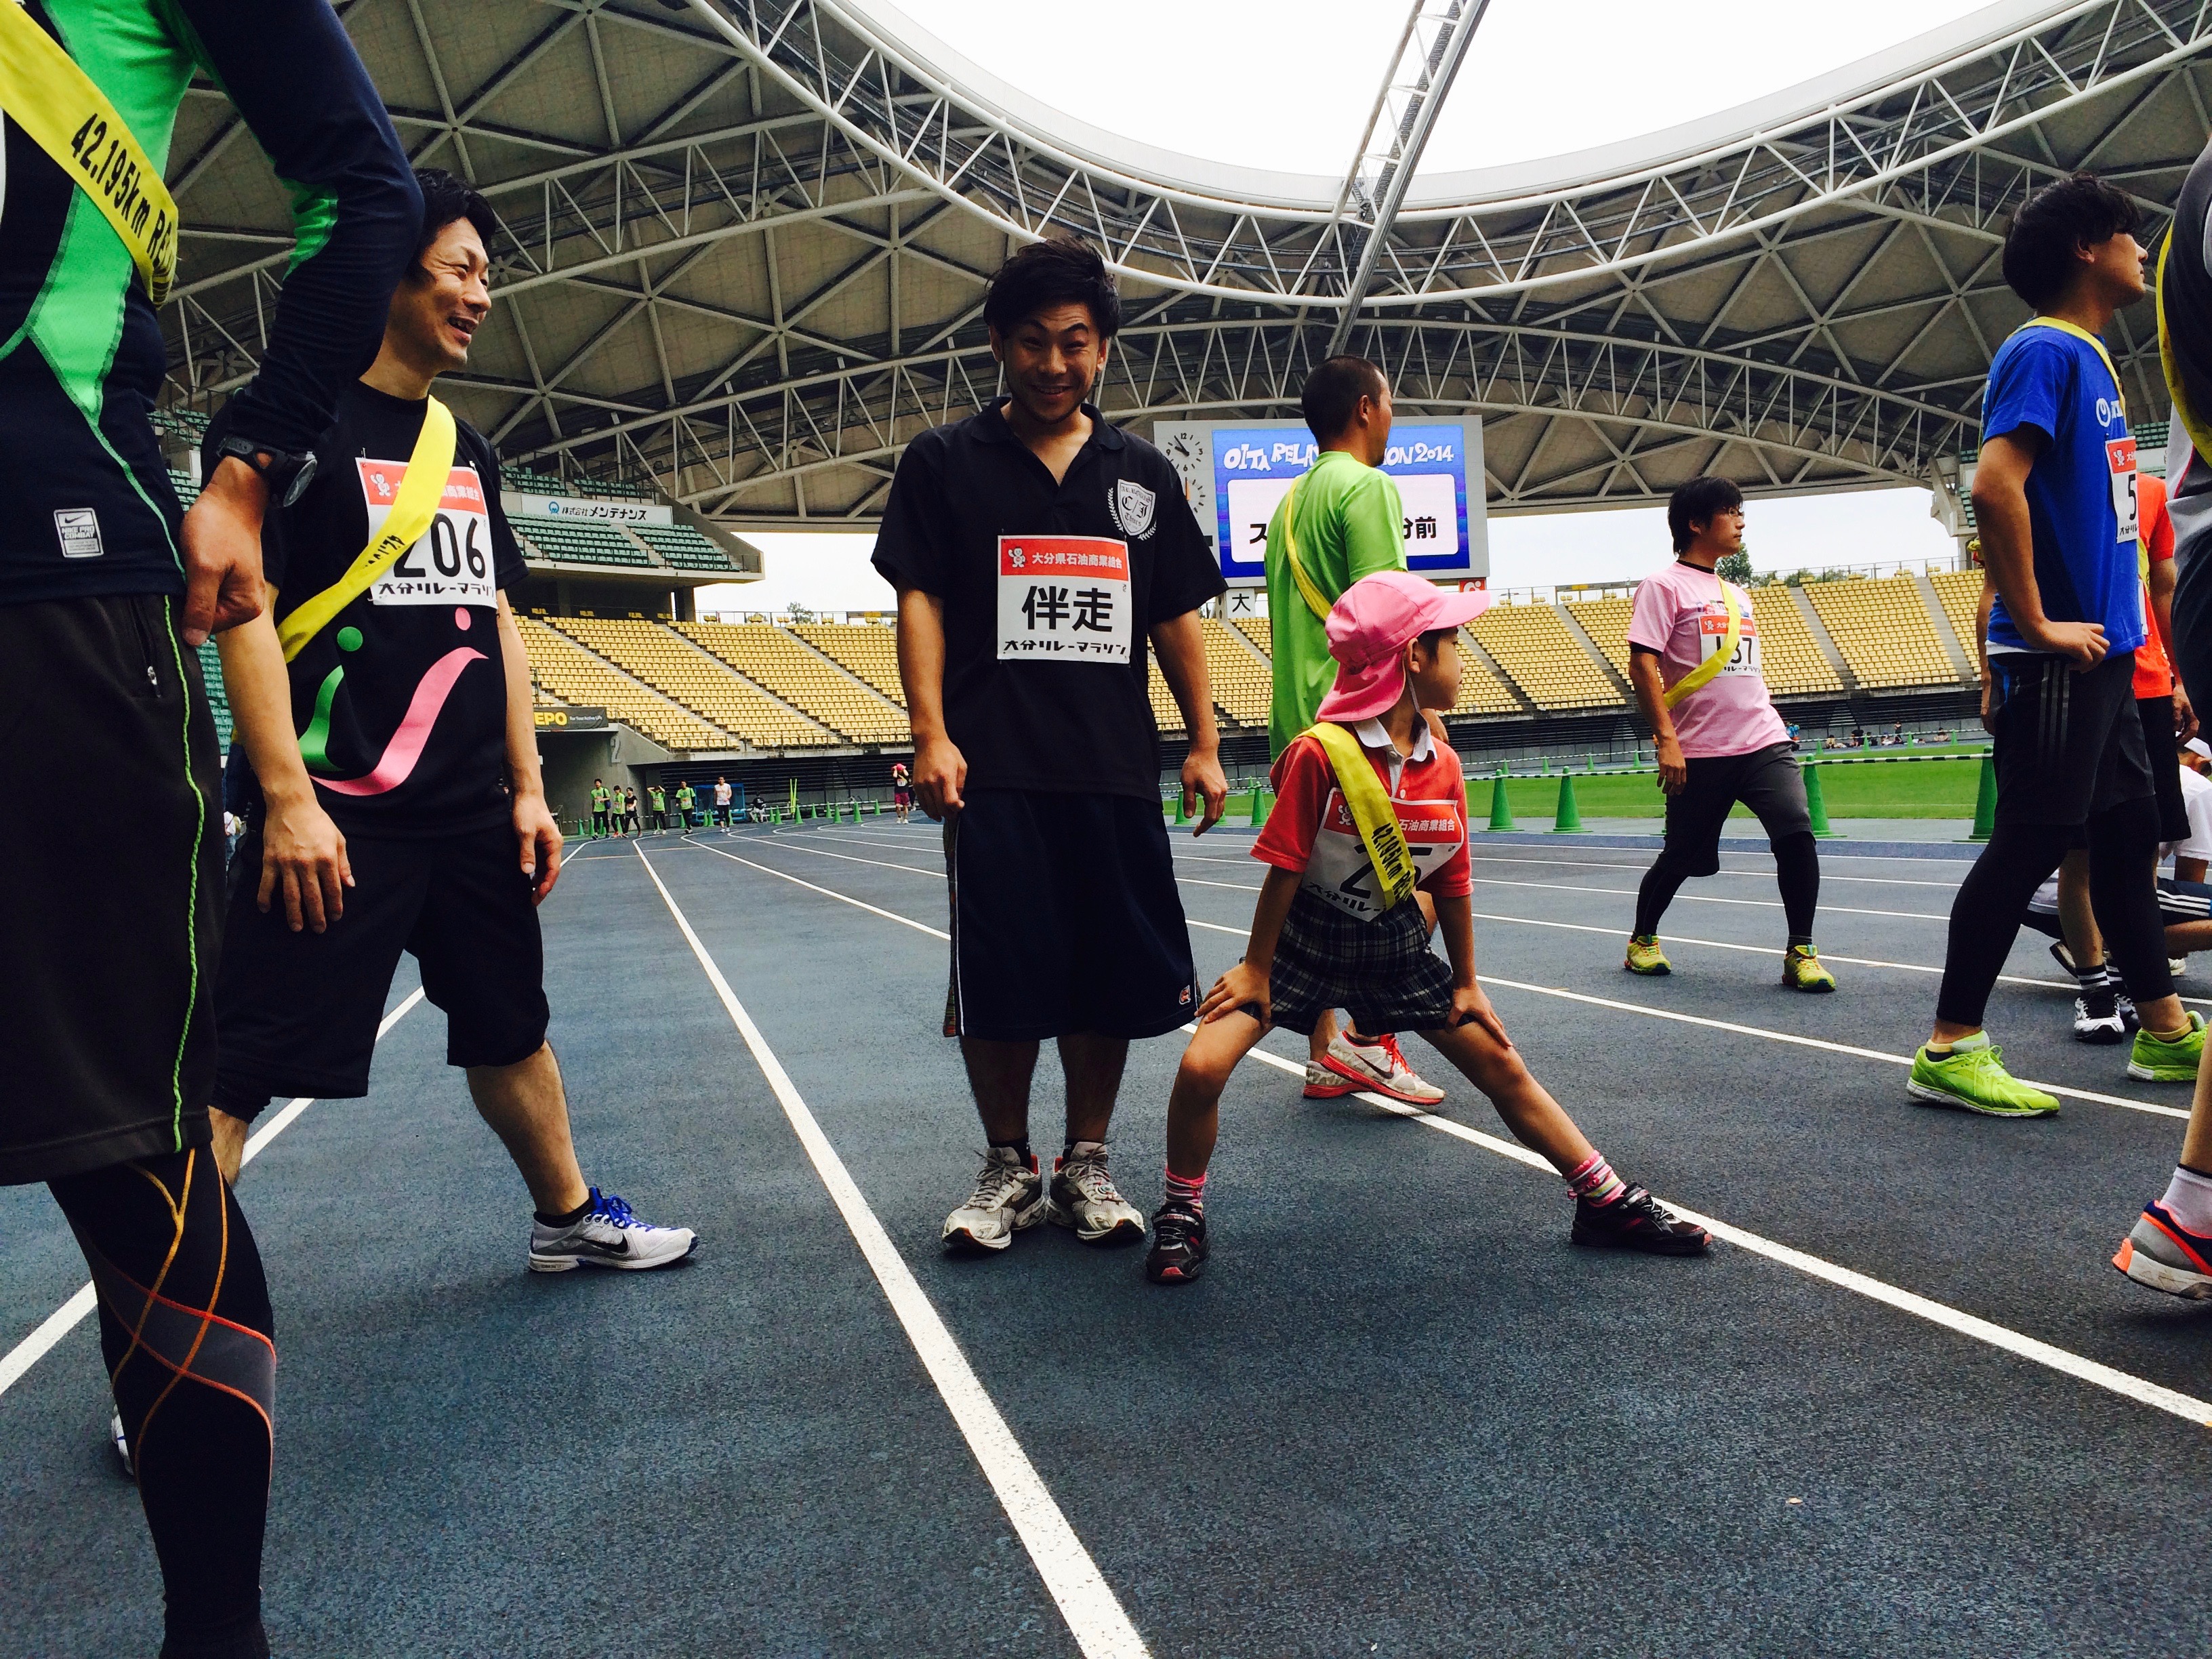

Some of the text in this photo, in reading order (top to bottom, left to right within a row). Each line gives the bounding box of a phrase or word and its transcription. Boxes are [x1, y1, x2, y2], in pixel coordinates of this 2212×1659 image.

[71, 112, 151, 239] 42.195km
[1223, 443, 1272, 472] OITA
[1414, 442, 1455, 463] 2014
[79, 525, 95, 533] PRO
[1031, 552, 1123, 570] 大分県石油商業組合
[1021, 586, 1113, 632] 伴走
[1231, 593, 1252, 613] 大
[1004, 640, 1126, 655] 大分リレーマラソン
[533, 712, 567, 726] EPO
[1398, 818, 1456, 832] 石油商業組合
